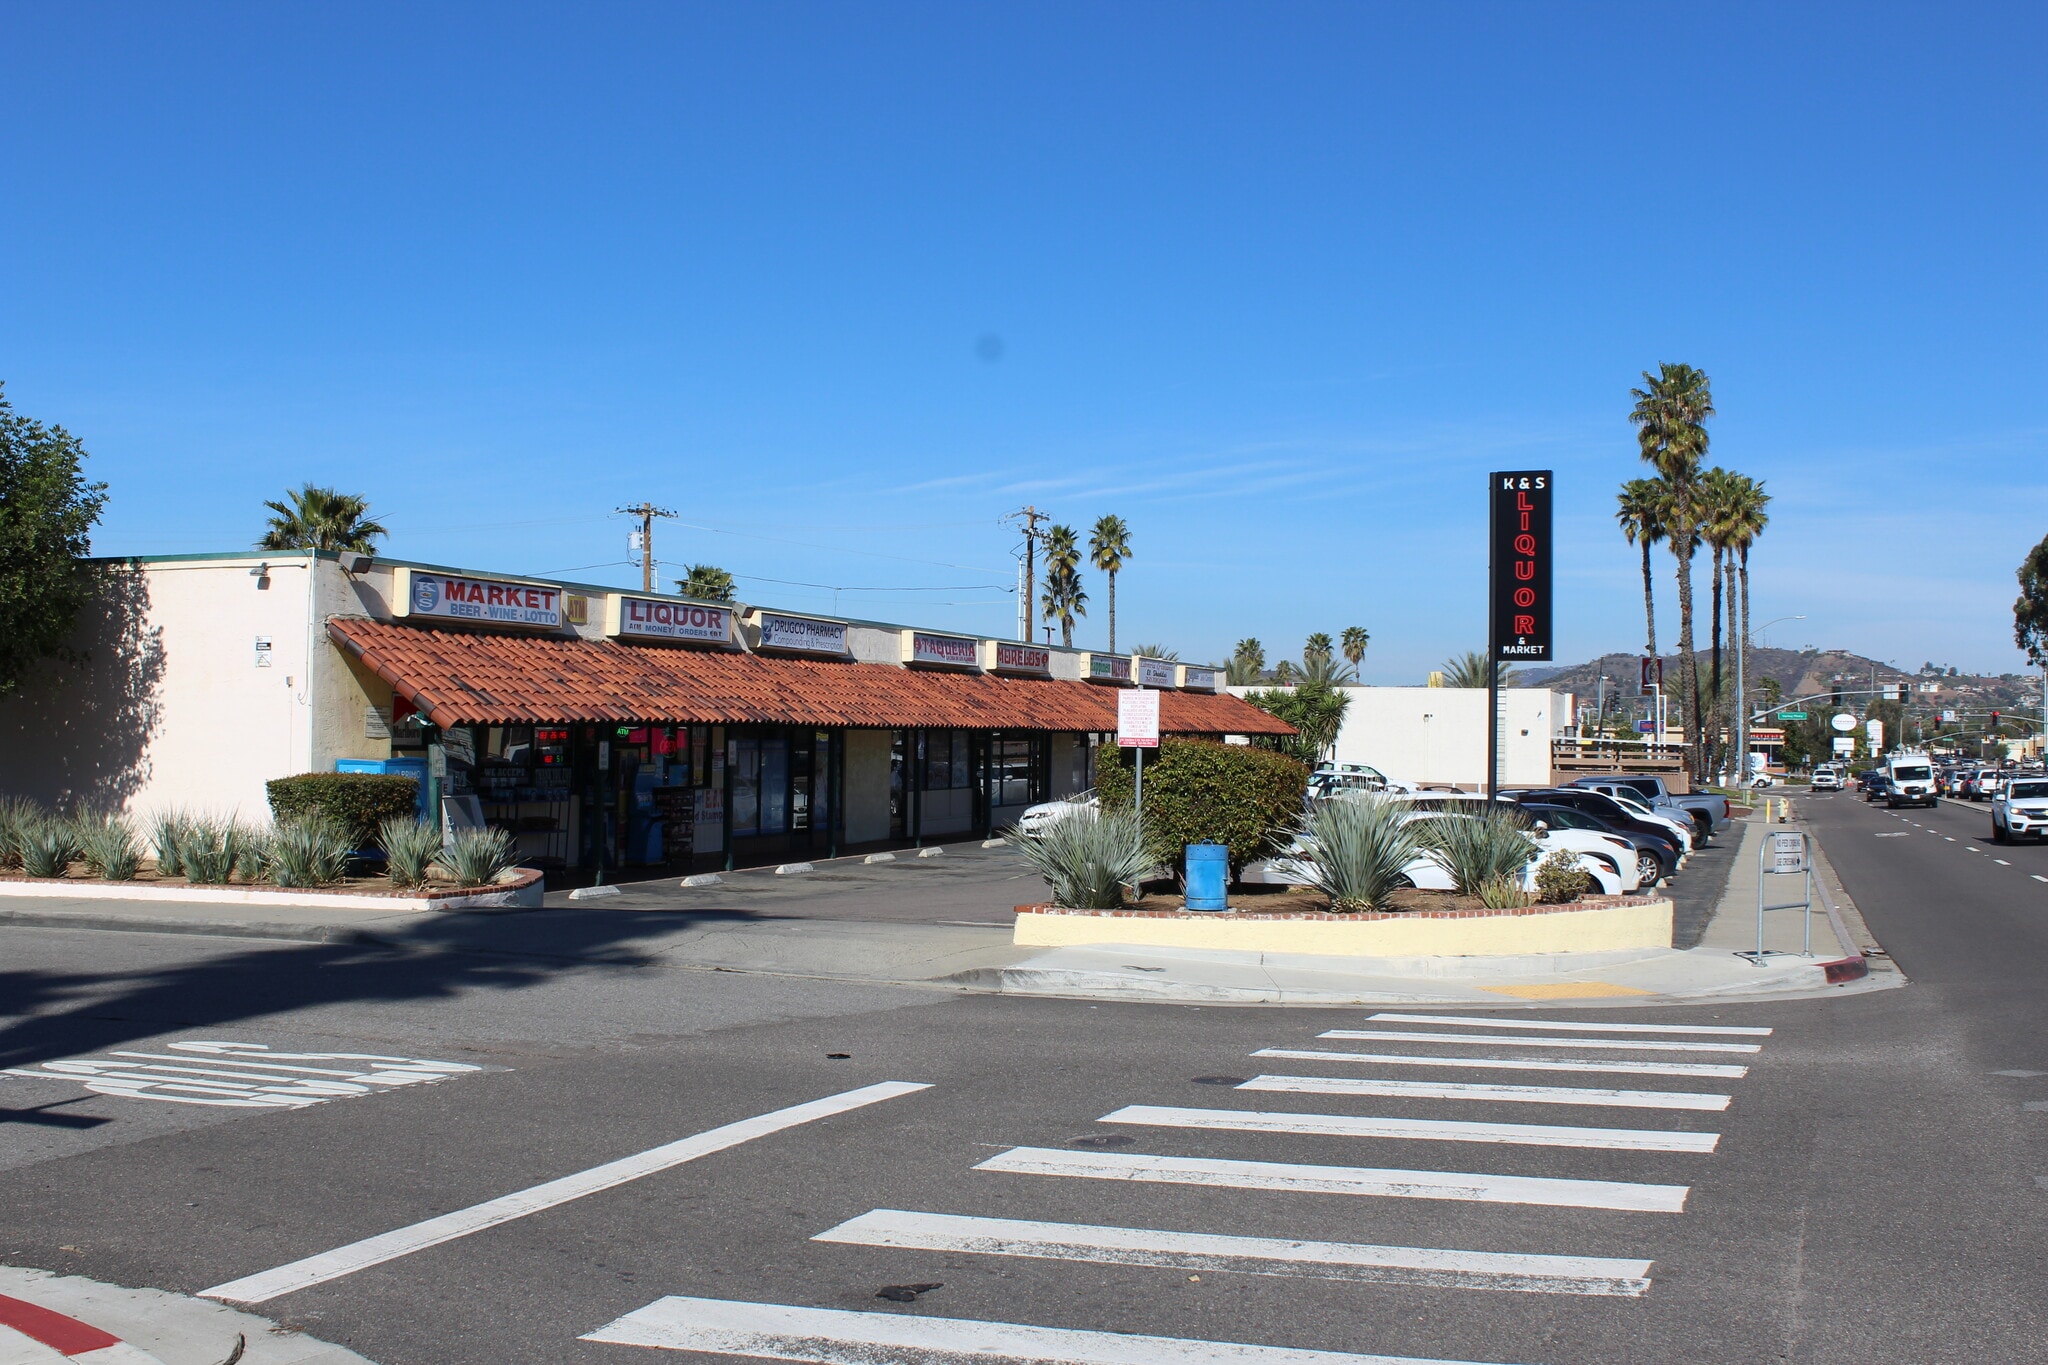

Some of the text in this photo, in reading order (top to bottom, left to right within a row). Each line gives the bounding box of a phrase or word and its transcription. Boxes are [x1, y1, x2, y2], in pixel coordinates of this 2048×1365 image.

[1503, 476, 1545, 490] K & S
[1514, 491, 1536, 634] LIQUOR
[445, 580, 555, 610] MARKET
[450, 603, 558, 624] BEER WINE LOTTO
[568, 599, 587, 619] ATM
[630, 601, 722, 629] LIQUOR
[645, 625, 673, 633] MONEY
[679, 628, 708, 637] ORDERS
[774, 620, 843, 639] DRUGCO PHARMACY
[774, 634, 843, 650] Compounding & Prescription
[920, 638, 976, 658] TAQUERIA
[1503, 645, 1544, 654] MARKET
[1518, 636, 1526, 645] &
[997, 647, 1040, 667] MORELOS
[393, 723, 421, 738] Marlboro
